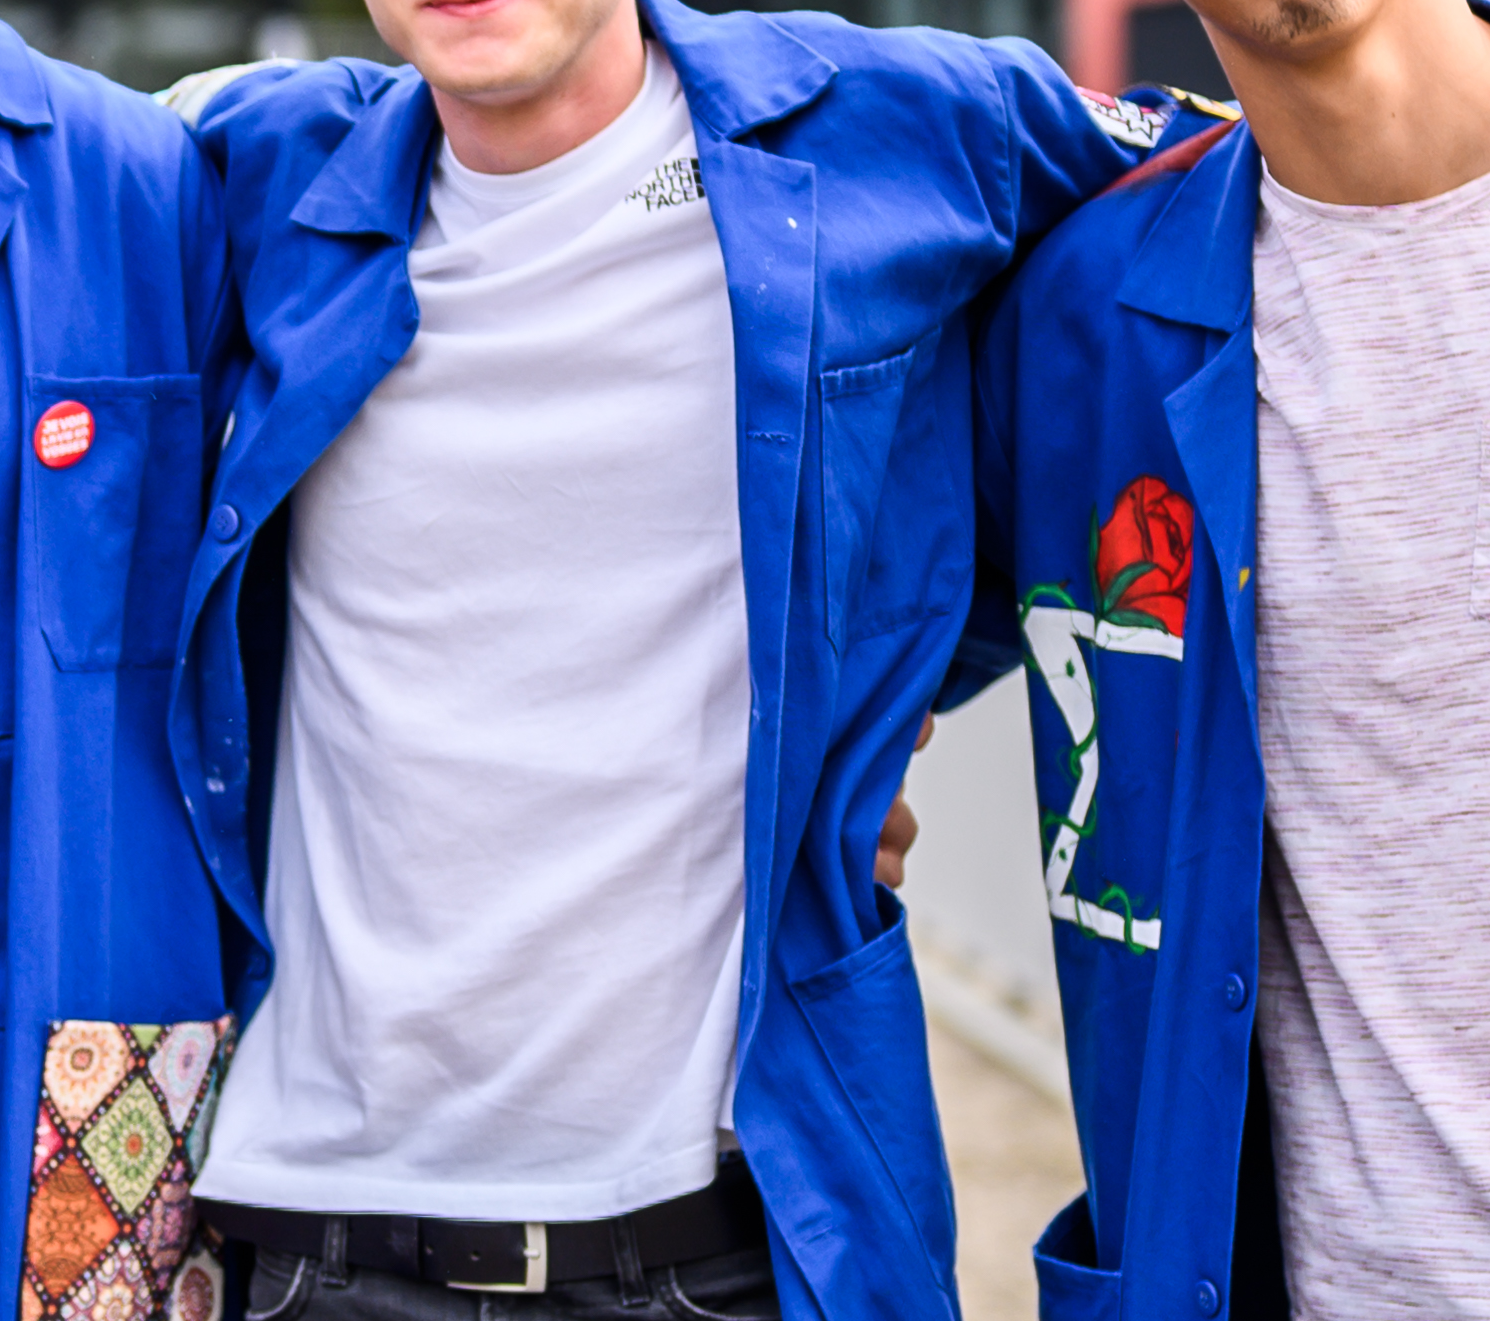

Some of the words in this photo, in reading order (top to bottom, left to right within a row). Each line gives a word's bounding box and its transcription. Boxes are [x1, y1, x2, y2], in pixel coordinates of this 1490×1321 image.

[653, 157, 689, 181] THE
[624, 170, 693, 203] NORTH
[644, 189, 697, 212] FACE
